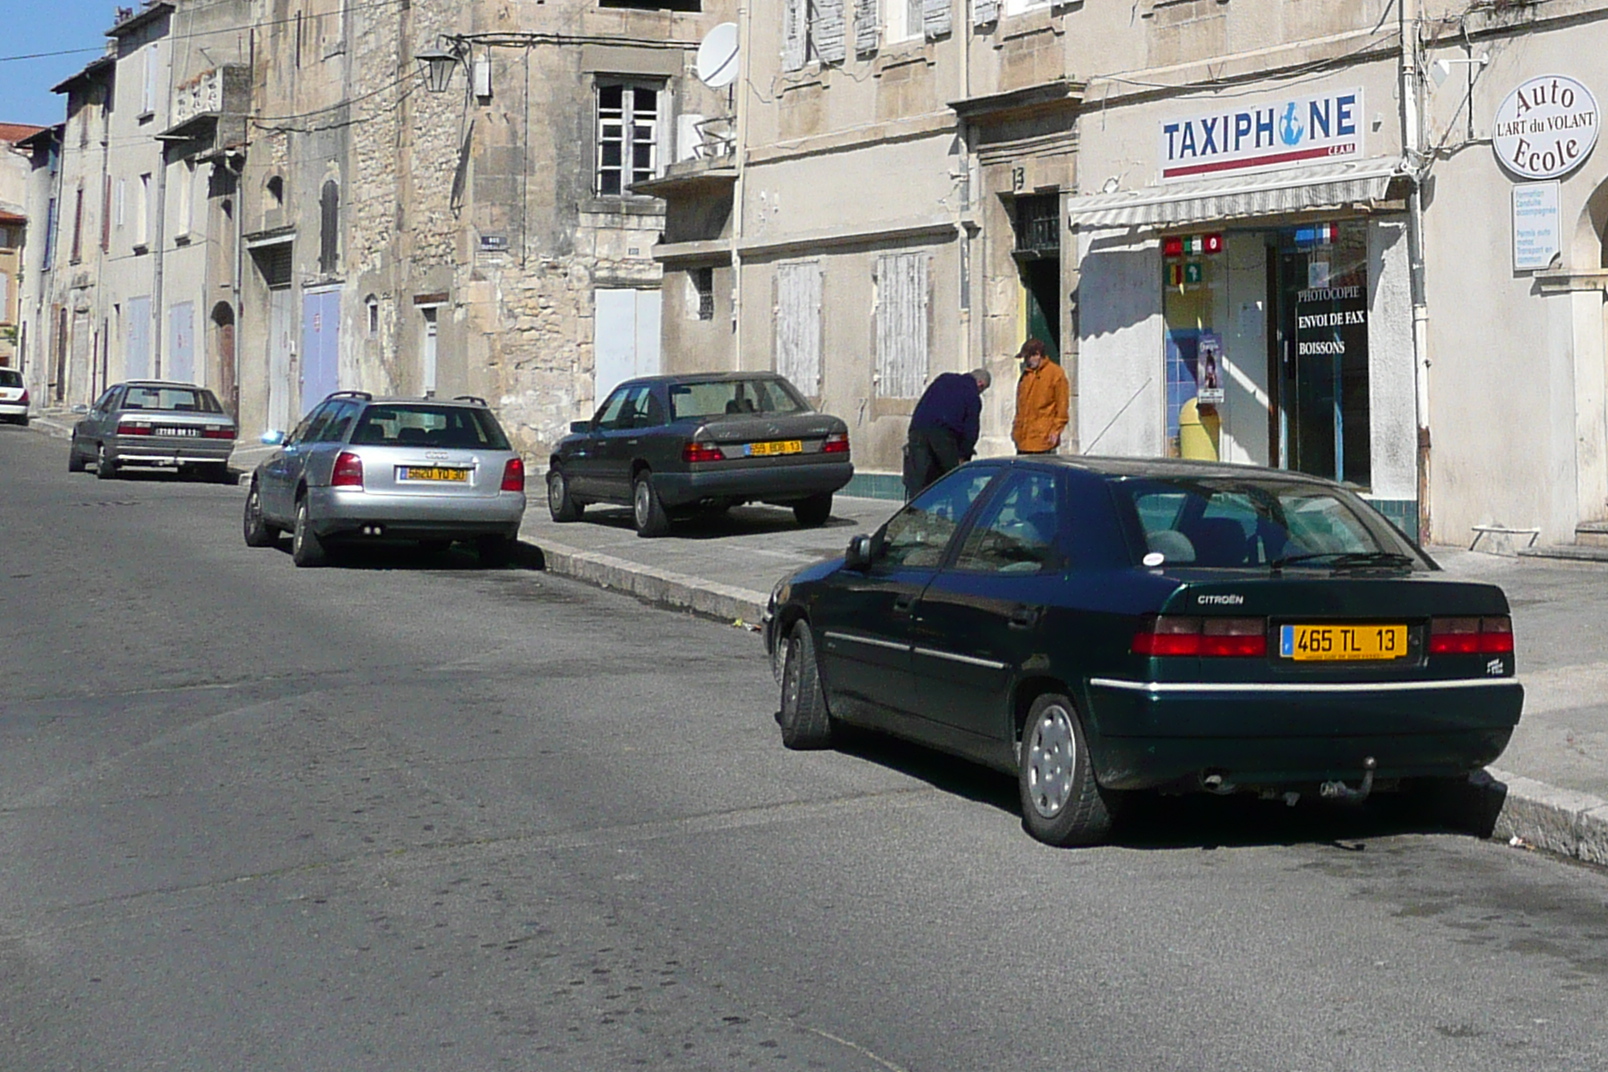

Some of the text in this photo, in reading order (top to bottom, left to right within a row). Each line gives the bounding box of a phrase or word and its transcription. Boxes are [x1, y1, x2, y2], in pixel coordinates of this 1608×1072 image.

[1516, 79, 1574, 118] Auto
[1497, 112, 1594, 137] L'ART du VOLANT
[1512, 138, 1580, 172] Ecole
[1298, 286, 1360, 302] PHOTOCOPIE
[1298, 310, 1365, 329] ENVOI DE FAX
[1299, 341, 1345, 355] BOISSONS
[1198, 593, 1244, 604] CITROËN
[1298, 629, 1395, 652] 465 TL 13
